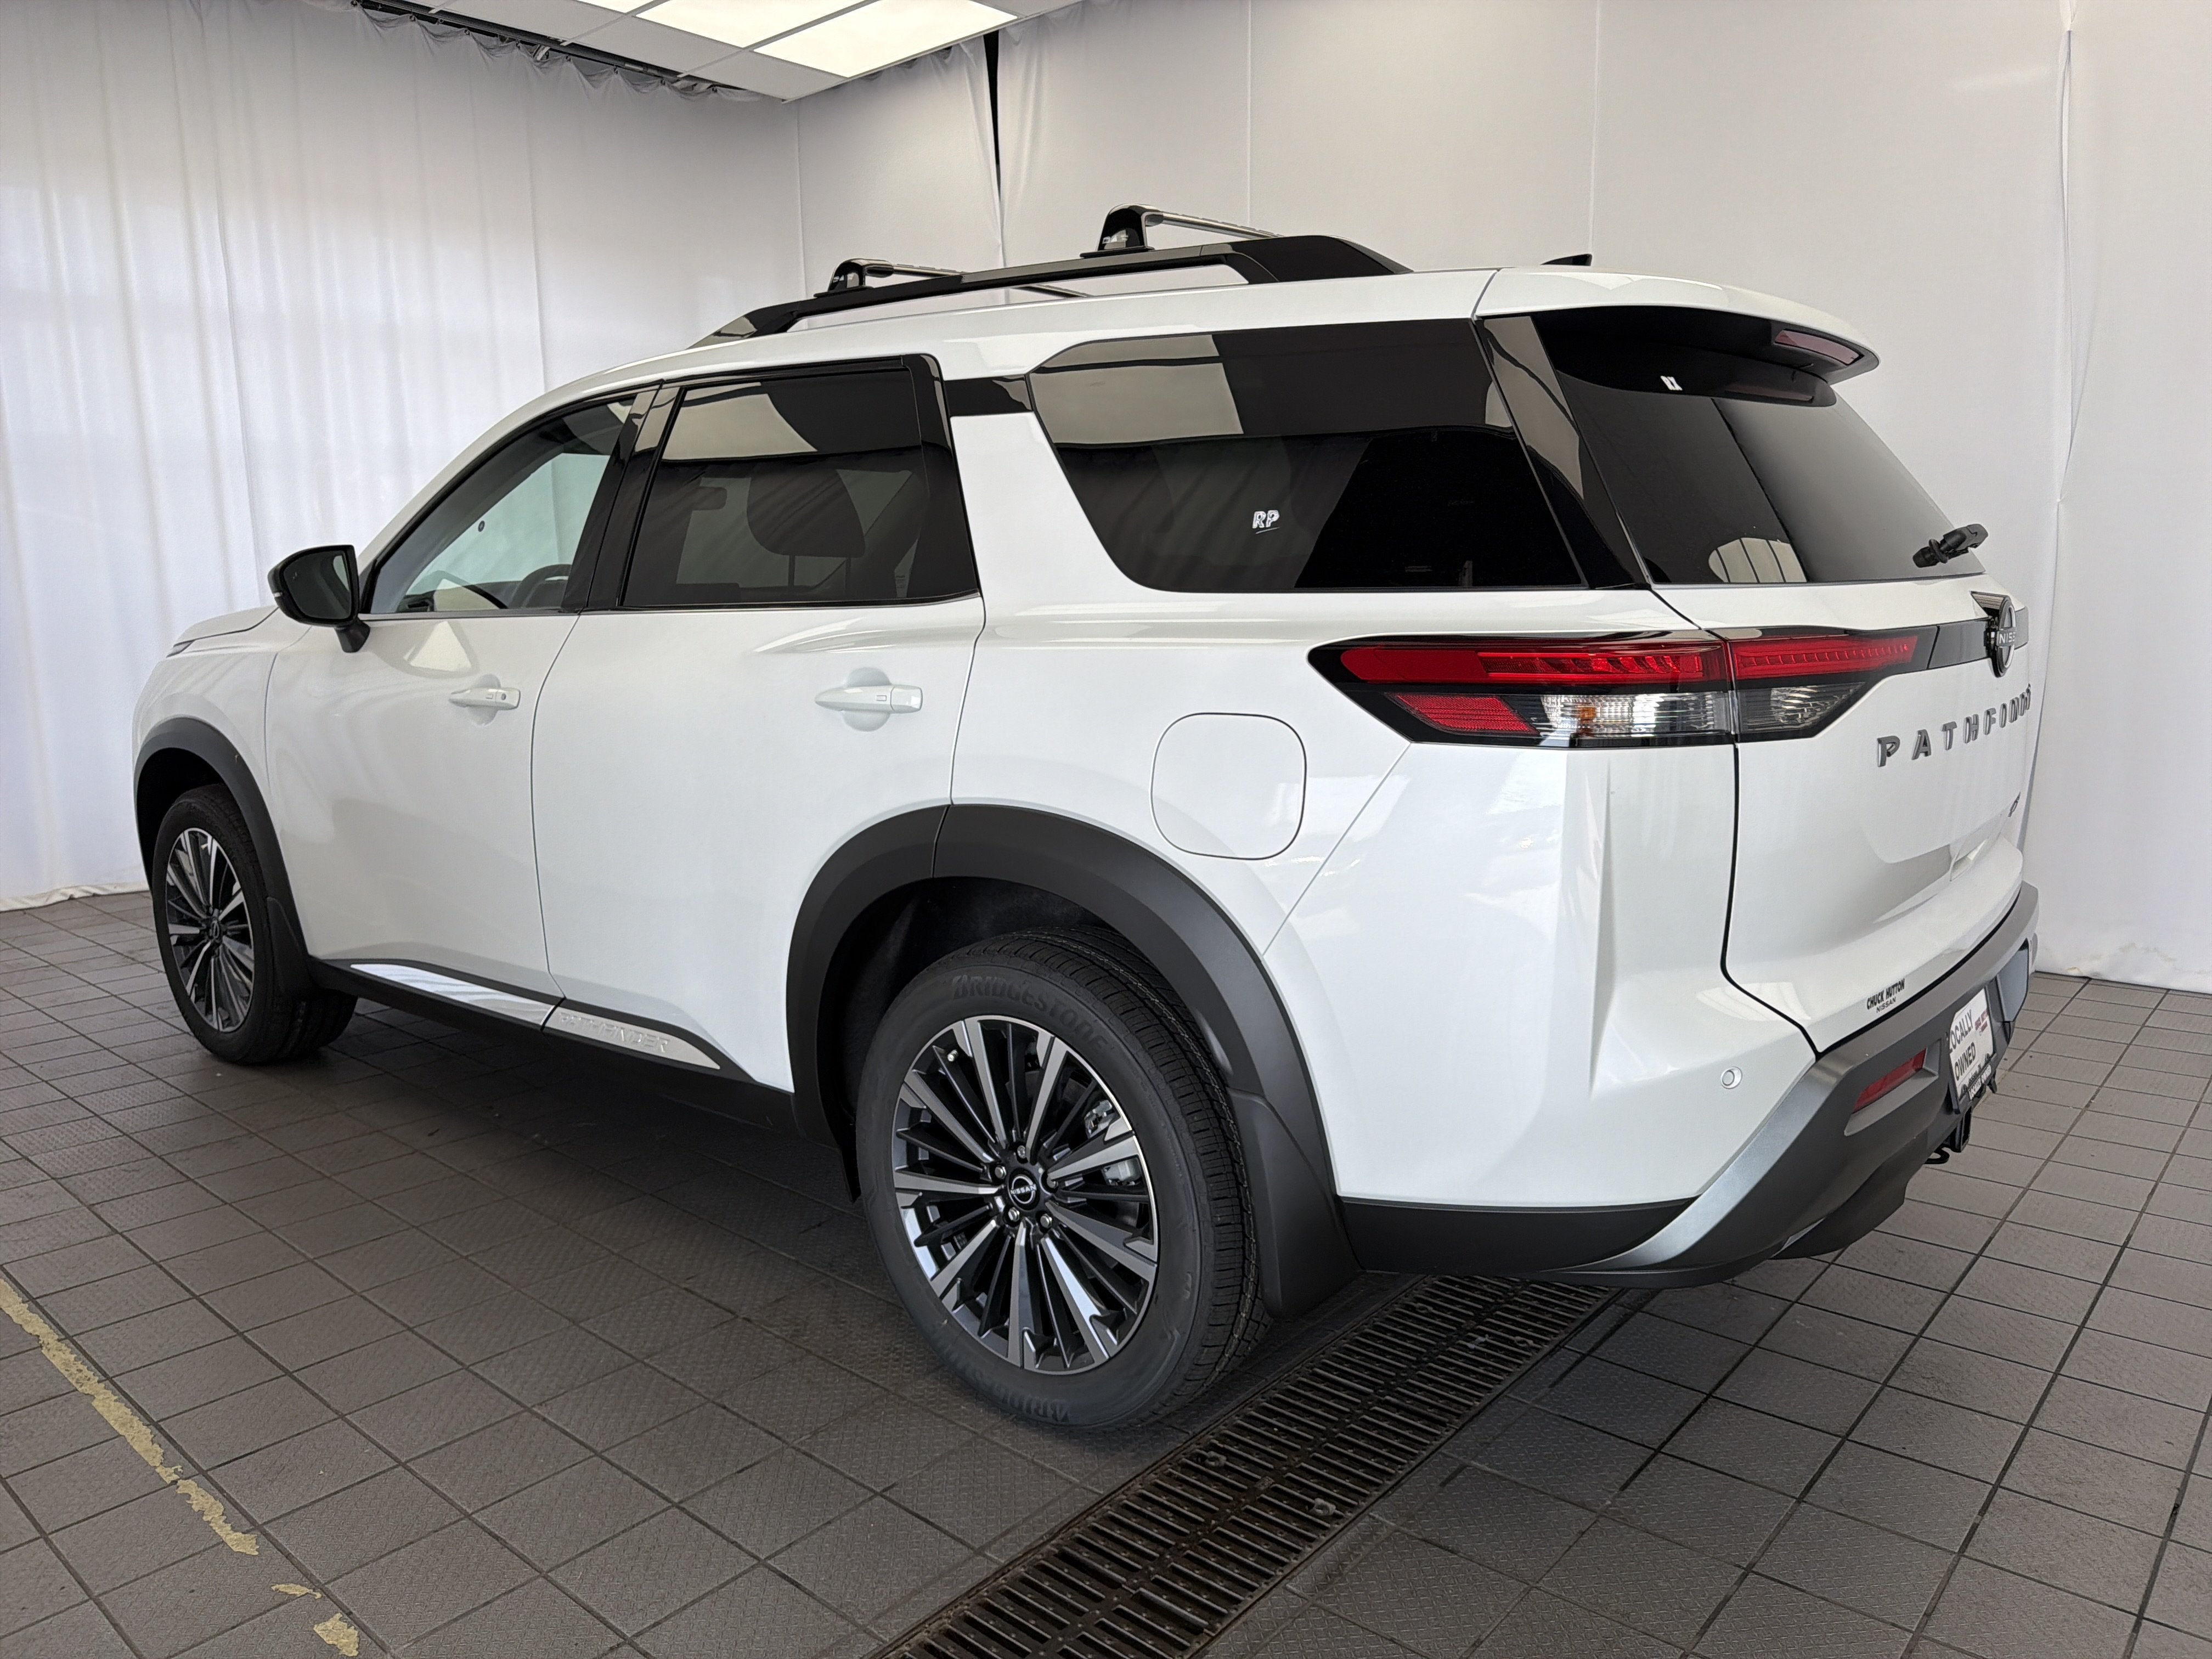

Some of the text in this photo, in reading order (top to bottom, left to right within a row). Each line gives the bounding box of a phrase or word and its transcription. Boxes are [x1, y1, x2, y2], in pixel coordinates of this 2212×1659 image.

[1252, 510, 1280, 528] RP
[1866, 978, 1905, 1010] CHUCK HUTTON
[1876, 996, 1897, 1013] NISSAN
[1954, 1041, 1976, 1081] OWNED
[1010, 1183, 1037, 1195] NISSAN
